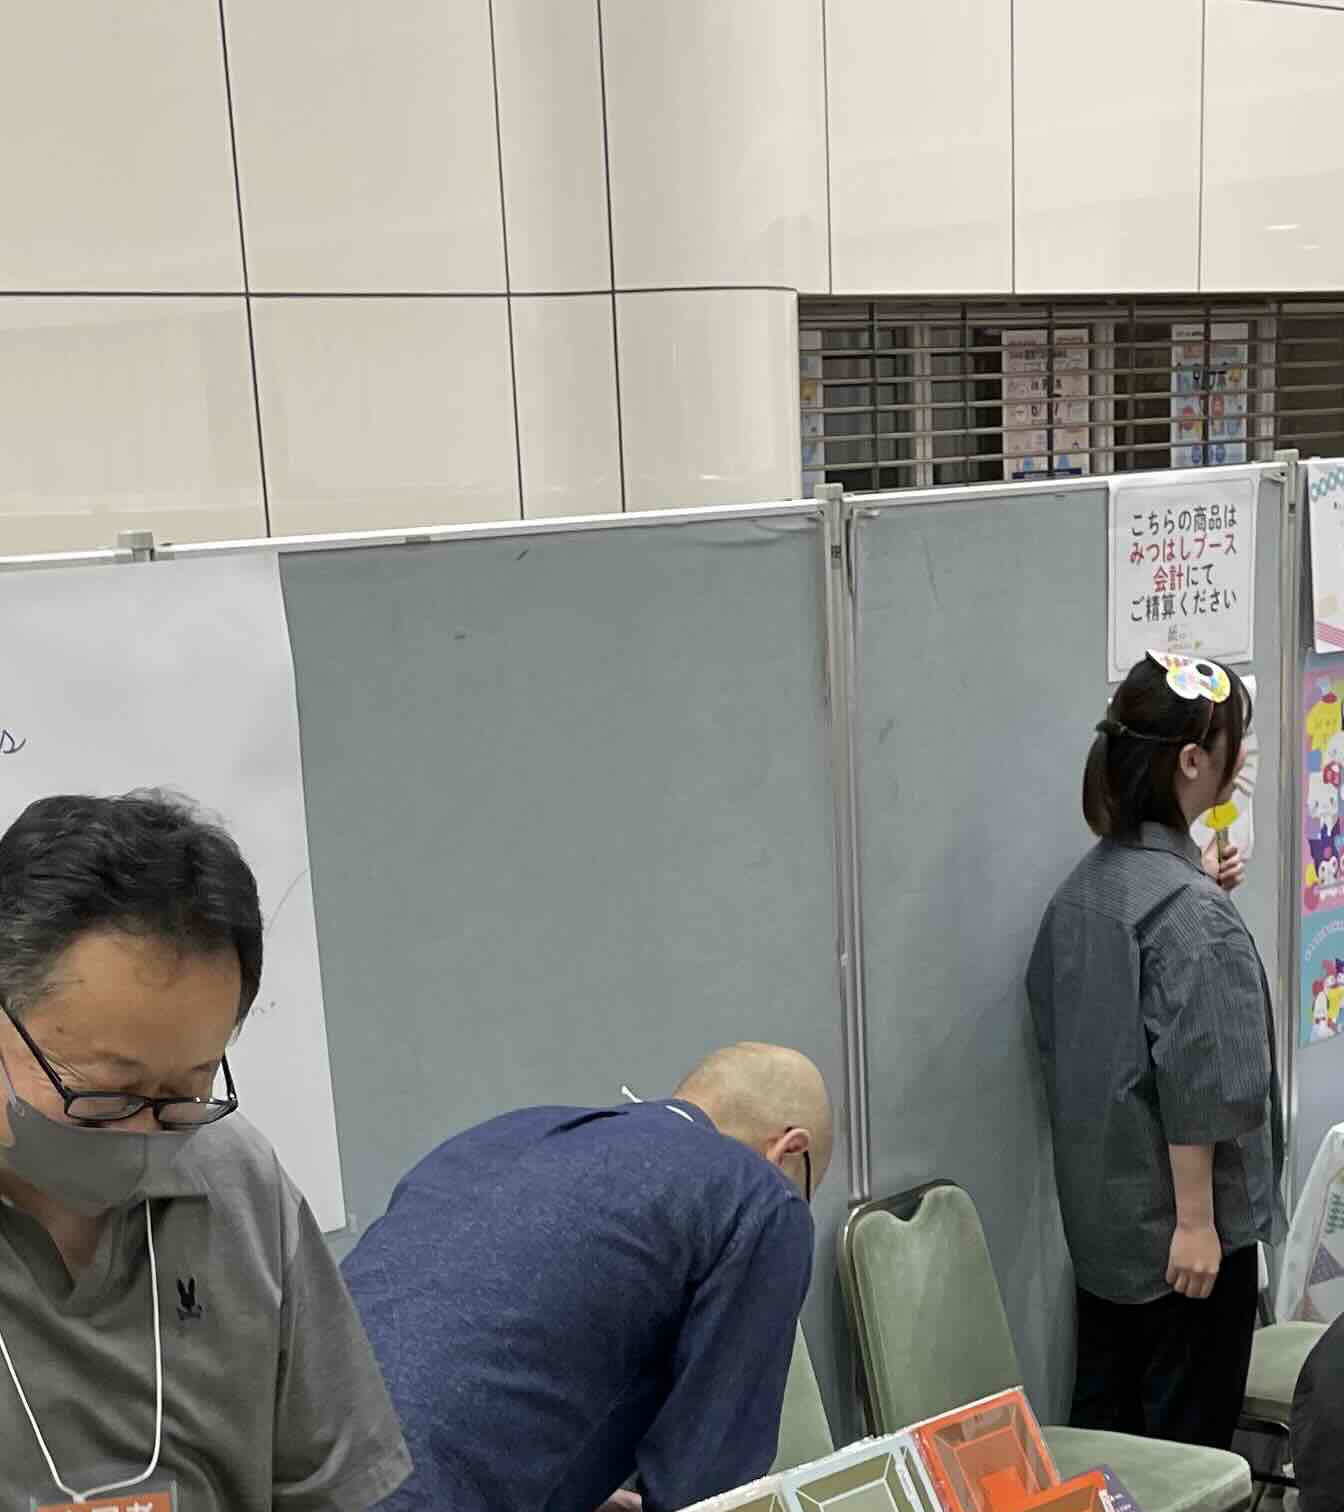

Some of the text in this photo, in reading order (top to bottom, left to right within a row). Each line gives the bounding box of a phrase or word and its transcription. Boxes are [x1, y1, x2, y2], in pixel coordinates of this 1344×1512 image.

[1130, 503, 1238, 537] こちらの商品は
[1153, 563, 1215, 593] 会計にて
[1130, 588, 1238, 622] ご精算ください
